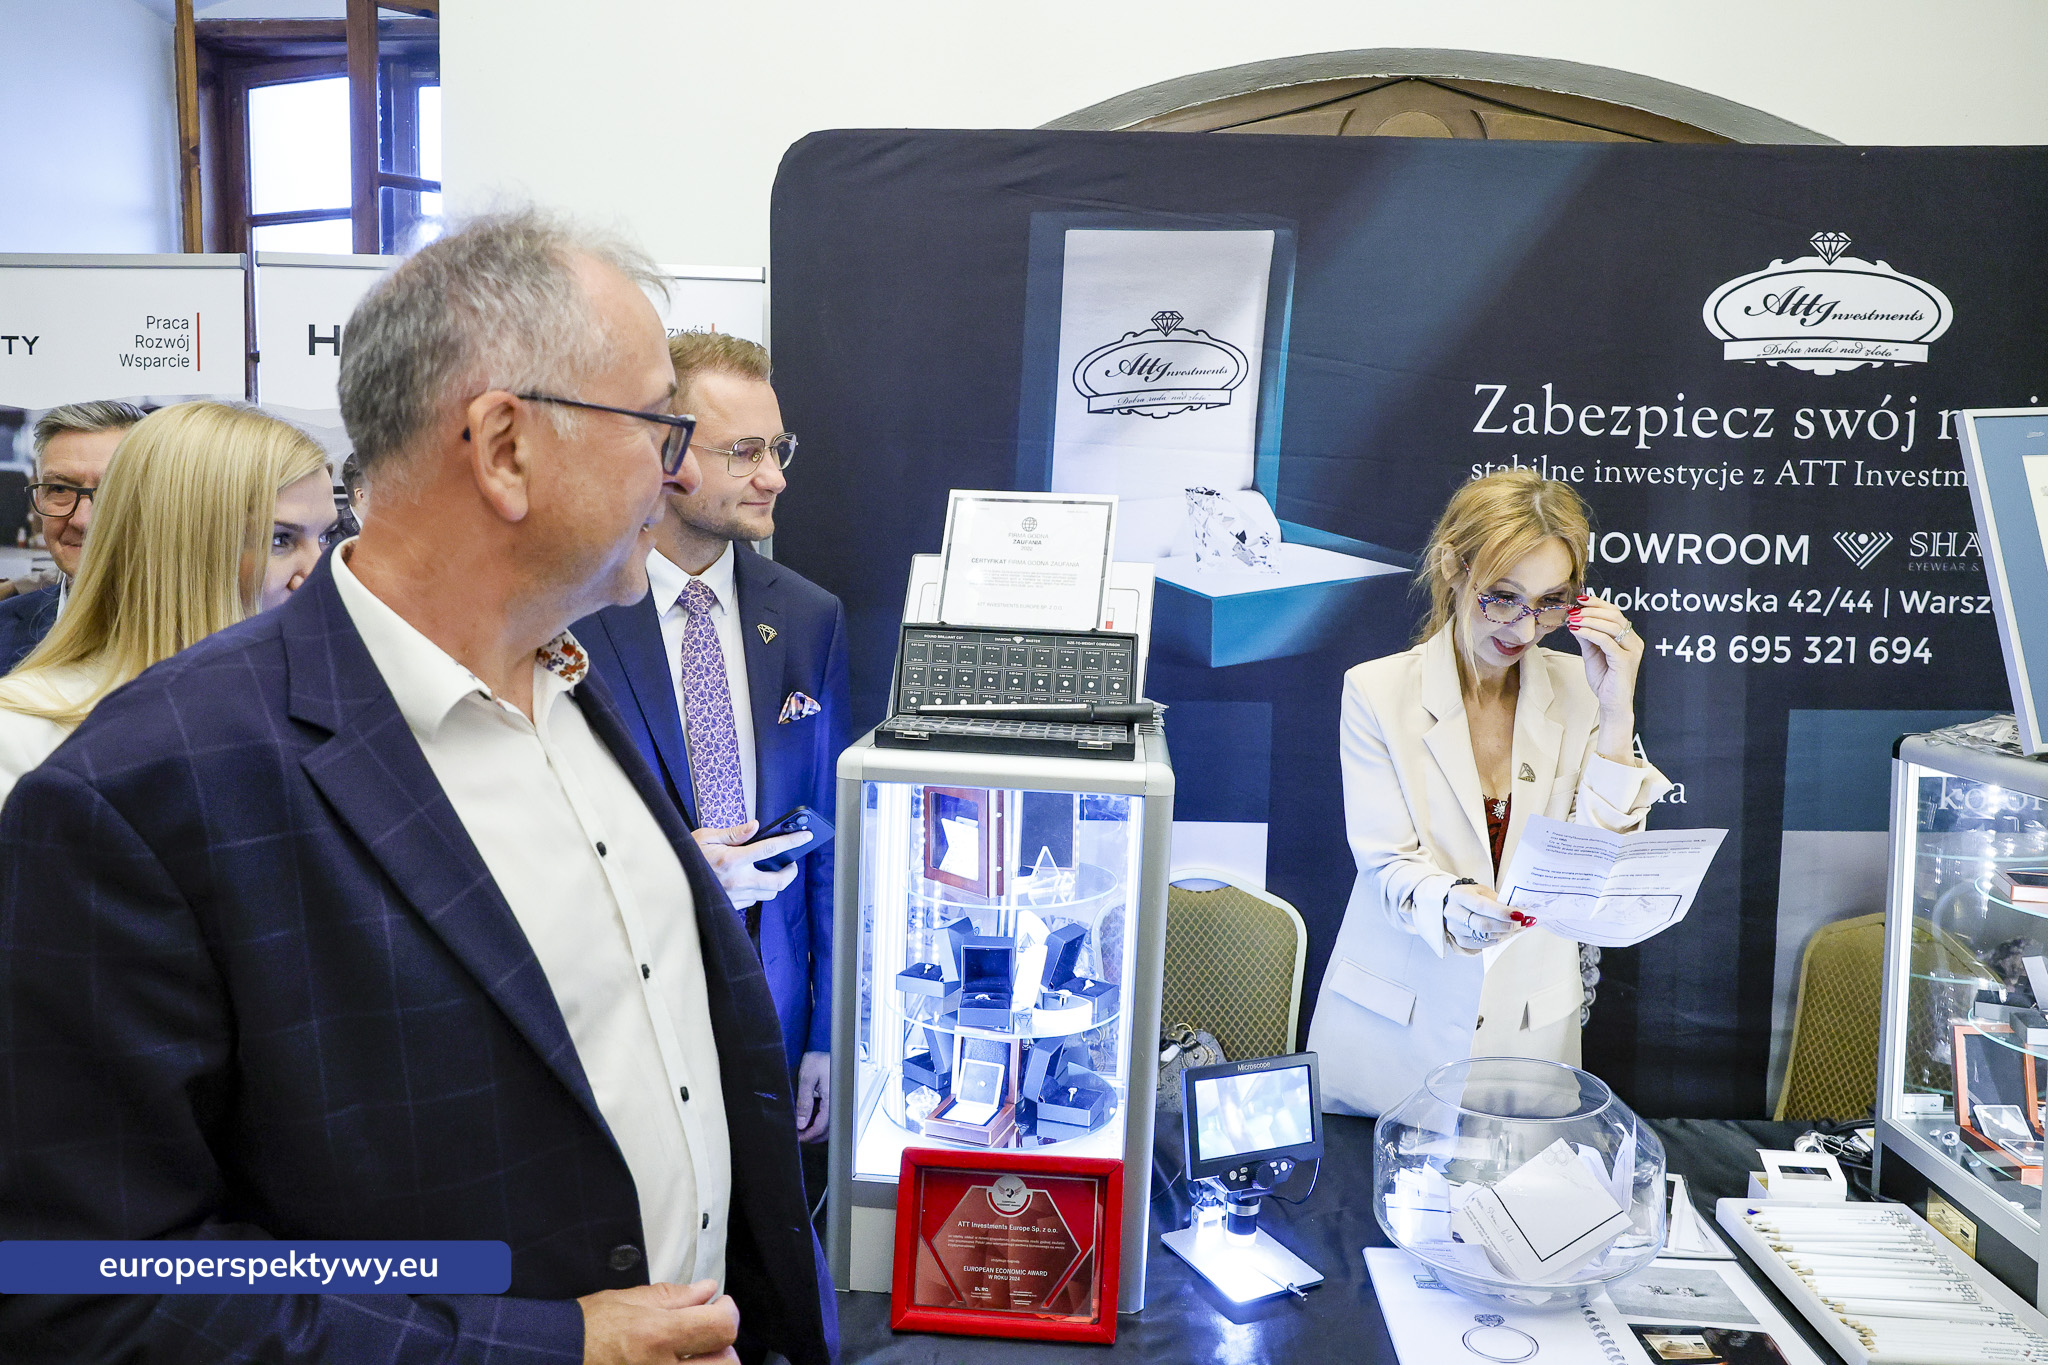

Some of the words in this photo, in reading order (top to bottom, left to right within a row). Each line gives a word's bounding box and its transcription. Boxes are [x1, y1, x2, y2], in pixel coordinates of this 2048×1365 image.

[146, 315, 190, 330] Praca
[135, 334, 190, 351] Rozwój
[1806, 340, 1839, 354] rada
[119, 353, 190, 371] Wsparcie
[1472, 382, 1775, 450] Zabezpiecz
[1793, 394, 1918, 453] swój
[1594, 459, 1744, 491] inwestycje
[1753, 469, 1765, 485] z
[1775, 460, 1847, 486] ATT
[971, 557, 1007, 565] CERTYFIKAT
[1908, 562, 1966, 572] EYEWEAR
[1586, 586, 1778, 614] Mokotowska
[1787, 587, 1874, 617] 42/44
[1899, 590, 1991, 615] Warsz
[1655, 635, 1717, 663] +48
[1728, 635, 1792, 664] 695
[1803, 636, 1856, 664] 321
[1869, 636, 1933, 665] 694
[1237, 1061, 1271, 1071] Microscope
[957, 1220, 970, 1228] ATT
[971, 1221, 1008, 1231] Investments
[1009, 1224, 1030, 1233] Europe
[963, 1265, 994, 1274] EUROPEAN
[995, 1266, 1027, 1276] ECONOMIC
[1027, 1269, 1048, 1277] AWARD
